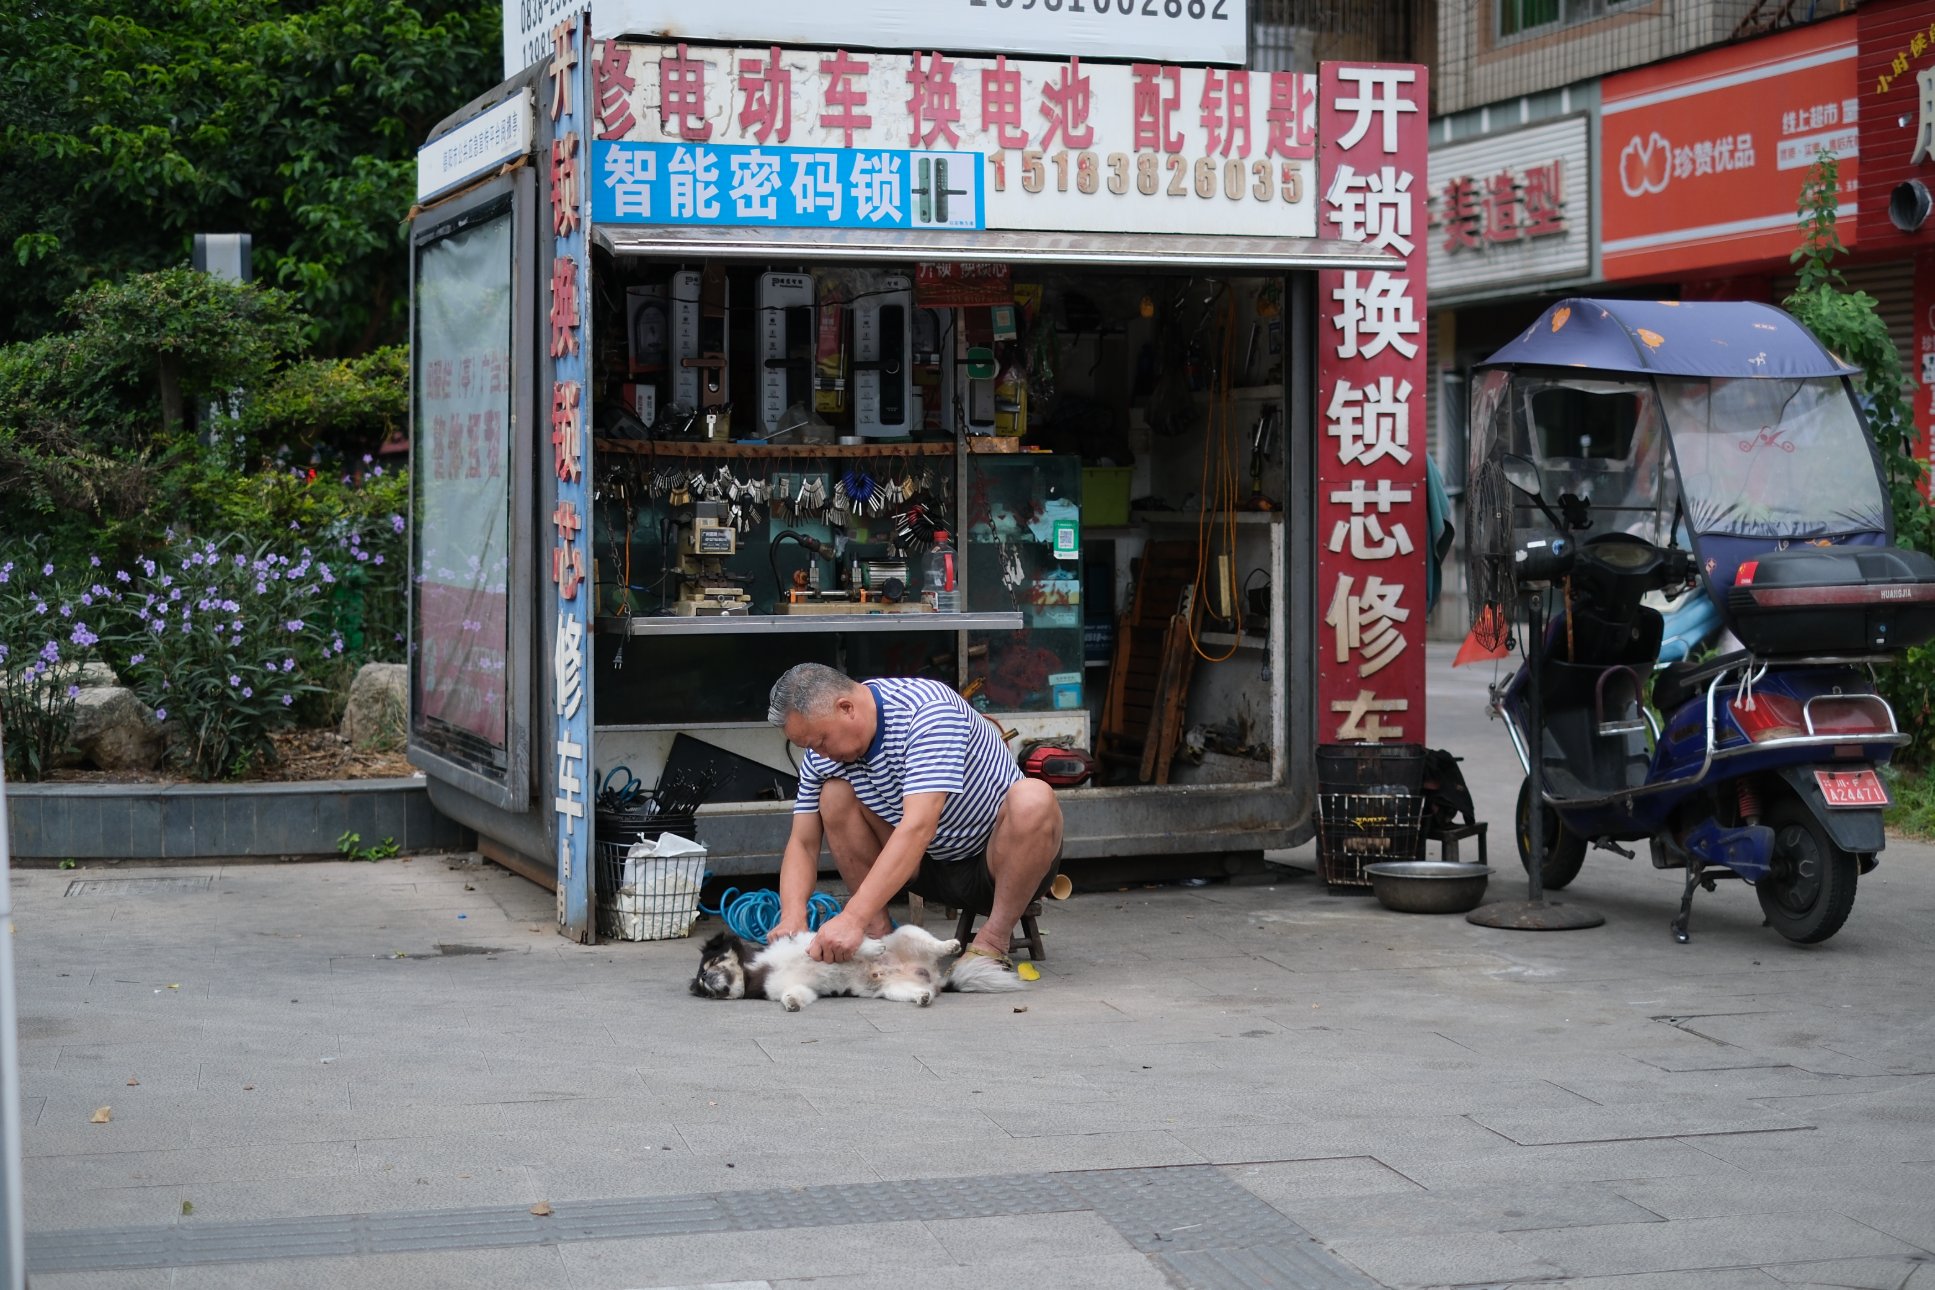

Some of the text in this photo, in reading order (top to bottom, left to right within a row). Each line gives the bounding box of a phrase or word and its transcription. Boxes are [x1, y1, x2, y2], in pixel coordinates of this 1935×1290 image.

[604, 144, 903, 223] 智能密码锁
[988, 149, 1304, 204] 15183826035
[1673, 133, 1755, 180] 珍赞优品
[1428, 158, 1569, 254] 美造型
[1880, 588, 1912, 600] HUANGJIA
